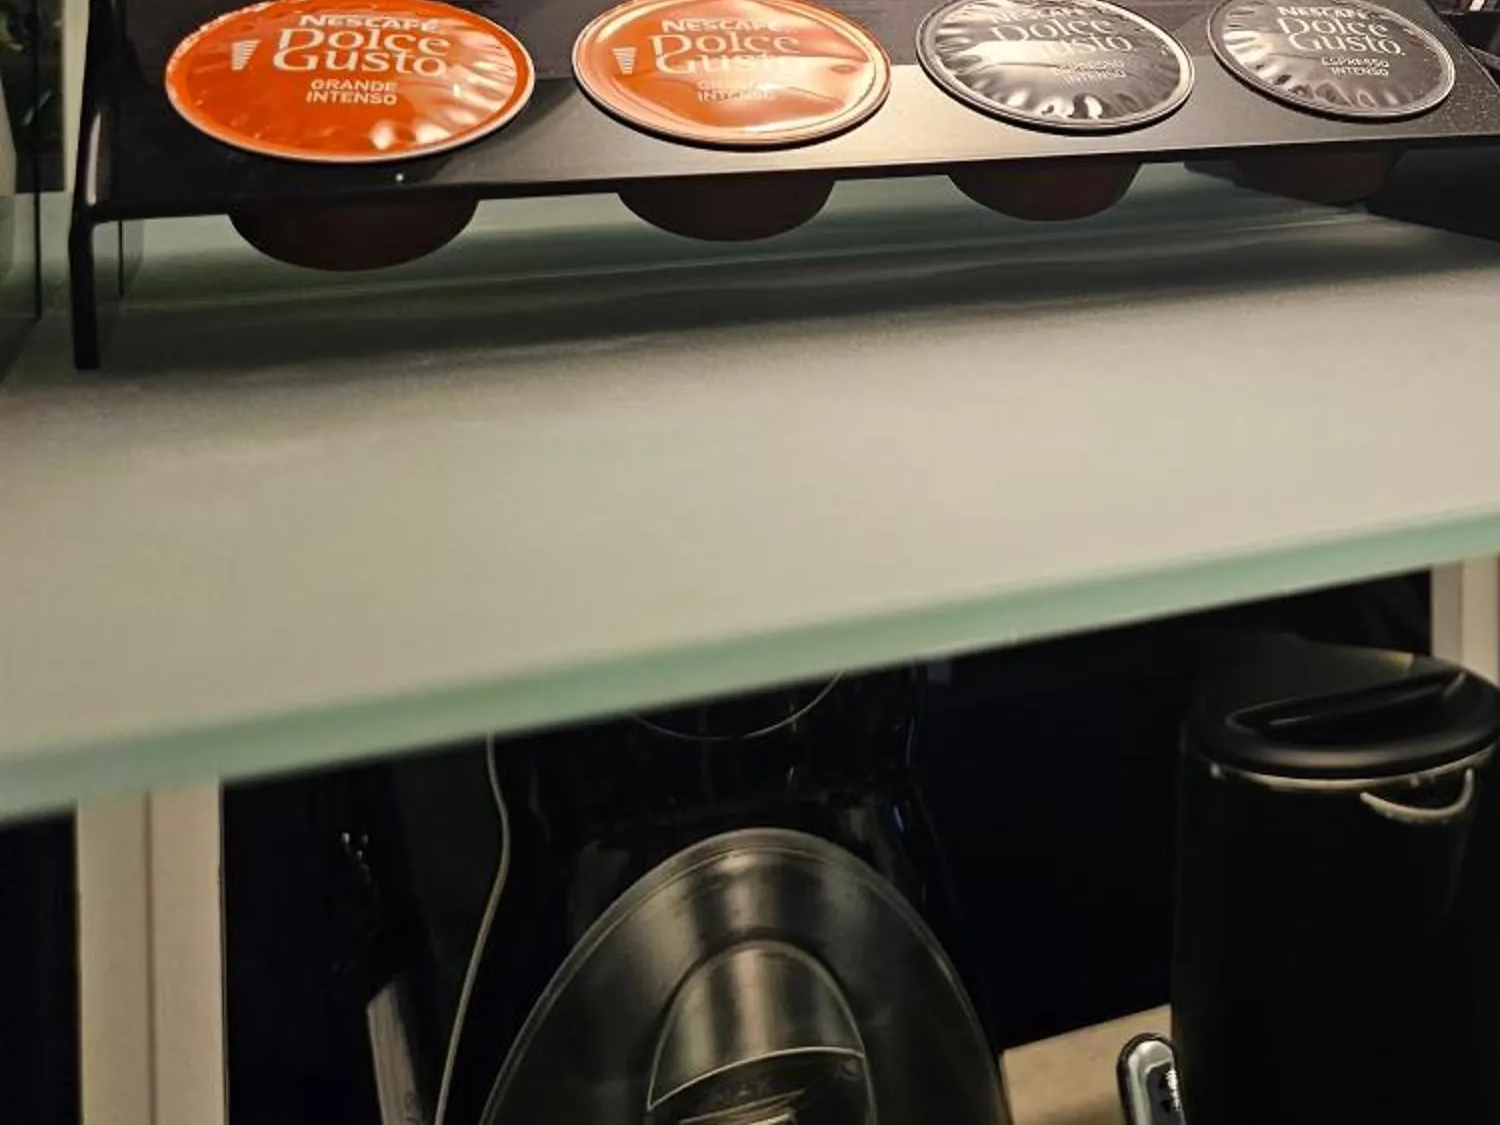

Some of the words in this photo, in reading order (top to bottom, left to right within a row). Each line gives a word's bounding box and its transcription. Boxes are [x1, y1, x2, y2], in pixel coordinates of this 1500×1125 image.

[990, 18, 1113, 43] Dolce
[1277, 17, 1389, 38] Dolce
[278, 27, 450, 56] Dolce
[649, 30, 802, 57] Dolce
[273, 48, 447, 77] Gusto
[306, 90, 398, 106] INTENSO
[311, 78, 398, 93] GRANDE
